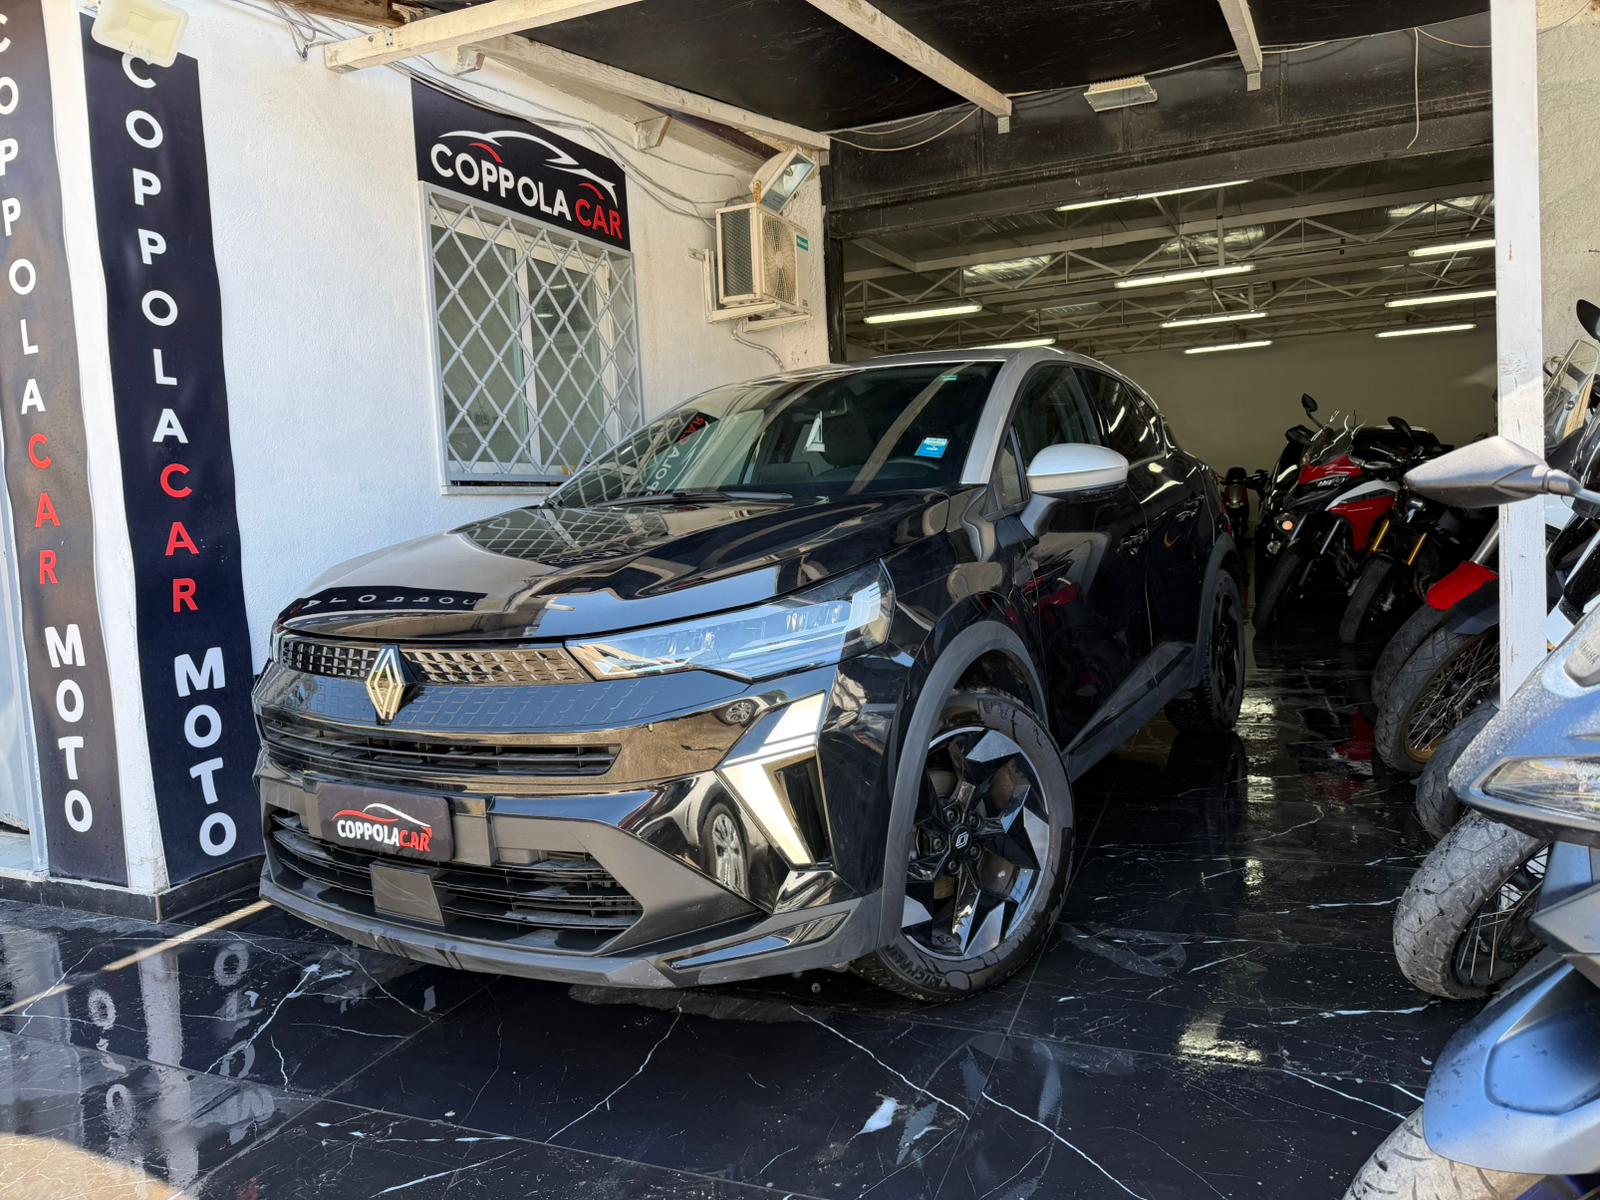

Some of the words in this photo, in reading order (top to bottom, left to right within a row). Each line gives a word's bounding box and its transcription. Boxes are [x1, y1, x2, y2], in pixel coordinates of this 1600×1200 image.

[121, 52, 189, 443] COPPOLA
[430, 142, 572, 221] COPPOLA
[575, 198, 624, 239] CAR
[28, 433, 60, 585] CAR
[44, 624, 93, 833] MOTO
[160, 463, 199, 613] CAR
[174, 647, 237, 857] MOTO
